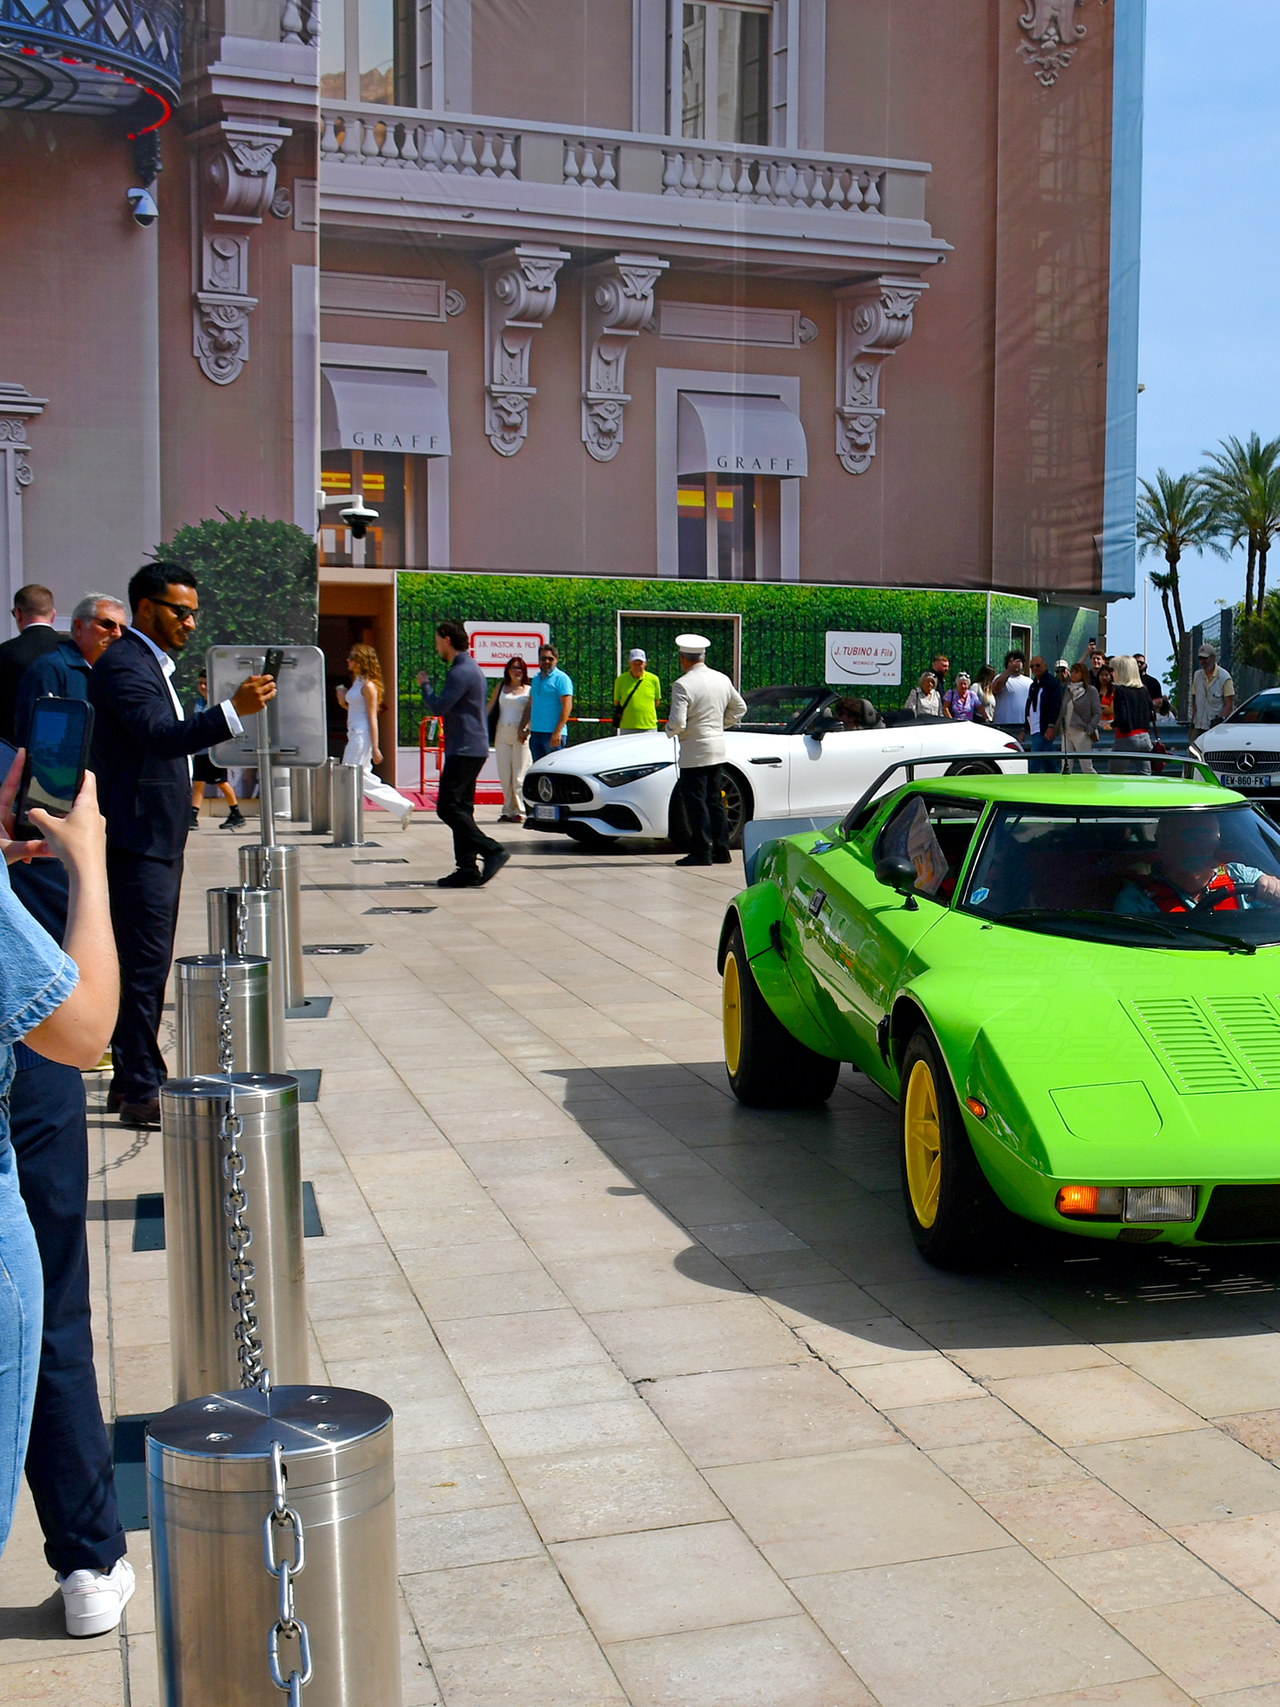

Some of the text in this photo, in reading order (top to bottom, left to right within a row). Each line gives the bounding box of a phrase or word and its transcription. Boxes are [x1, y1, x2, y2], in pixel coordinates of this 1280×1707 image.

[353, 432, 437, 449] GRAFF
[717, 455, 794, 471] GRAFF
[490, 641, 514, 649] PASTOR
[834, 646, 893, 657] J. TUBINO & Fils
[1226, 776, 1264, 786] EW-860-FK
